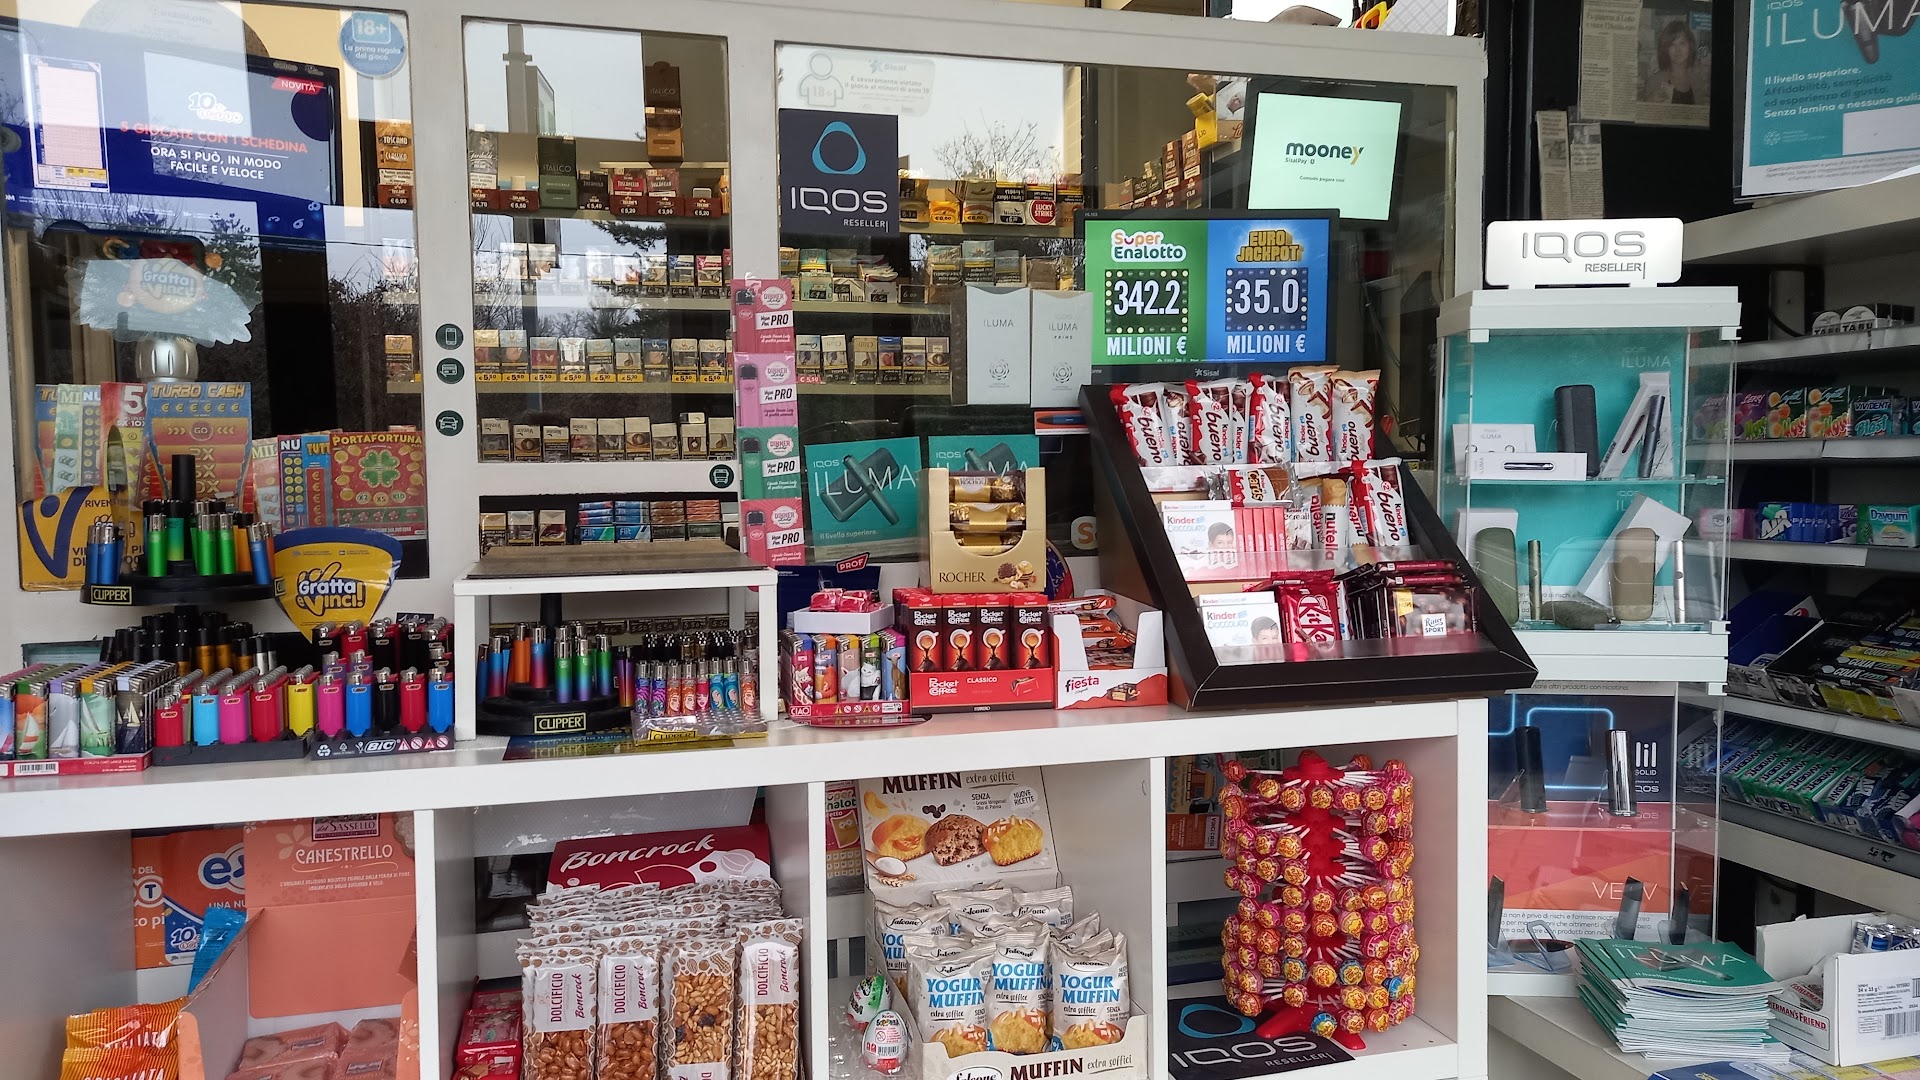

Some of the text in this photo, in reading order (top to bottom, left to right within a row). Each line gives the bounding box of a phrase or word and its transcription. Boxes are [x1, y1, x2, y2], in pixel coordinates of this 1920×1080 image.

[355, 18, 387, 36] 18+
[857, 77, 898, 85] severamente
[1774, 73, 1805, 84] livello
[1807, 66, 1862, 81] superiore.
[281, 79, 316, 92] NOVITÀ
[1764, 74, 1893, 97] Affidabilità, semplicità
[1764, 88, 1889, 107] ed esperienza di gusto.
[1764, 109, 1796, 119] Senza
[1799, 104, 1835, 115] lamina
[1847, 97, 1894, 109] nessuna
[132, 123, 193, 140] GIOCATE
[198, 133, 229, 144] CON
[241, 137, 307, 153] SCHEDINA
[151, 146, 282, 170] ORA SI PUÒ, IN MODO
[1285, 142, 1365, 165] mooney
[170, 160, 264, 180] FACILE E VELOCE
[542, 164, 572, 173] ITALICO
[790, 186, 888, 215] IQOS
[1035, 203, 1053, 211] LUCKY
[1034, 210, 1054, 218] STRIKE
[1114, 232, 1162, 248] Super
[1249, 230, 1287, 247] EURO
[1114, 245, 1184, 260] Enalotto
[1236, 245, 1302, 262] JACKPOT
[1522, 230, 1647, 263] IQOS
[143, 270, 190, 286] Gratta
[763, 292, 785, 300] DINNER
[1113, 279, 1181, 316] 342.2
[1234, 278, 1300, 314] 35.0
[770, 313, 789, 326] PRO
[983, 319, 1014, 328] ILUMA
[1049, 322, 1078, 331] ILUMA
[1106, 335, 1187, 356] MILIONI €
[1226, 333, 1306, 354] MILIONI €
[1621, 355, 1671, 368] ILUMA
[1203, 368, 1220, 377] Sisal
[152, 384, 247, 398] TURBO CASH
[774, 388, 793, 400] PRO
[1854, 400, 1890, 411] VIVIDENT
[193, 426, 208, 434] GO
[1855, 414, 1889, 436] Blast
[332, 433, 422, 447] PORTAFORTUNA
[1137, 417, 1162, 464] bueno
[1206, 411, 1222, 461] bueno
[1306, 413, 1320, 456] bueno
[936, 451, 961, 460] IQOS
[777, 460, 795, 472] PRO
[813, 459, 840, 468] IQOS
[814, 464, 917, 498] ILUMA
[774, 512, 795, 520] DINNER
[1167, 515, 1195, 524] Kinder
[1377, 491, 1400, 541] bueno
[1870, 509, 1909, 524] Daygum
[781, 532, 800, 544] PRO
[824, 530, 879, 540] livello superiore.
[1325, 512, 1338, 560] nutella
[839, 559, 865, 572] PROF
[939, 571, 986, 583] ROCHER
[93, 588, 130, 601] CLIPPER
[298, 580, 357, 595] Gratta
[914, 611, 937, 620] Pocket
[914, 616, 937, 625] Coffee
[947, 610, 971, 619] Pocket
[948, 616, 971, 625] Coffee
[1019, 609, 1042, 618] Pocket
[1206, 611, 1237, 620] Kinder
[1834, 667, 1864, 678] GOLIA
[929, 678, 960, 689] Pocket
[967, 676, 997, 684] CLASSICO
[1065, 675, 1100, 693] fiesta
[1563, 683, 1589, 691] prodotti
[929, 686, 959, 696] Coffee
[790, 707, 811, 715] CIAO
[538, 715, 584, 730] CLIPPER
[368, 740, 394, 751] BIC
[1635, 741, 1657, 768] lil
[882, 771, 1016, 795] MUFFIN extra soffici
[971, 792, 991, 801] SENZA
[1013, 789, 1032, 798] NUOVE
[1014, 796, 1035, 806] RICETTE
[331, 820, 376, 832] SASSELLO
[295, 844, 394, 865] CANESTRELLO
[560, 834, 715, 874] Boncrock
[138, 866, 156, 874] DEL
[889, 917, 920, 927] falcone
[1527, 912, 1542, 920] privo
[1550, 912, 1566, 920] rischi
[1572, 913, 1596, 921] fornisce
[1569, 921, 1600, 930] altrimenti
[171, 927, 197, 945] 10
[1557, 929, 1582, 937] prodotti
[758, 948, 769, 996] DOLCIFICIO
[992, 963, 1045, 977] YOGUR
[634, 964, 648, 1010] Boncrock
[926, 978, 982, 993] YOGUR
[994, 977, 1049, 991] MUFFIN
[1060, 974, 1113, 989] YOGUR
[572, 972, 586, 1019] Boncrock
[614, 964, 626, 1014] DOLCIFICIO
[550, 972, 563, 1023] DOLCIFICIO
[929, 991, 985, 1008] MUFFIN
[1013, 993, 1028, 1001] soffice
[1062, 989, 1120, 1004] MUFFIN
[1078, 1006, 1096, 1014] soffice
[1799, 1011, 1827, 1031] FRIEND
[1170, 1034, 1318, 1068] IQOS
[1010, 1054, 1133, 1080] MUFFIN extra soffici
